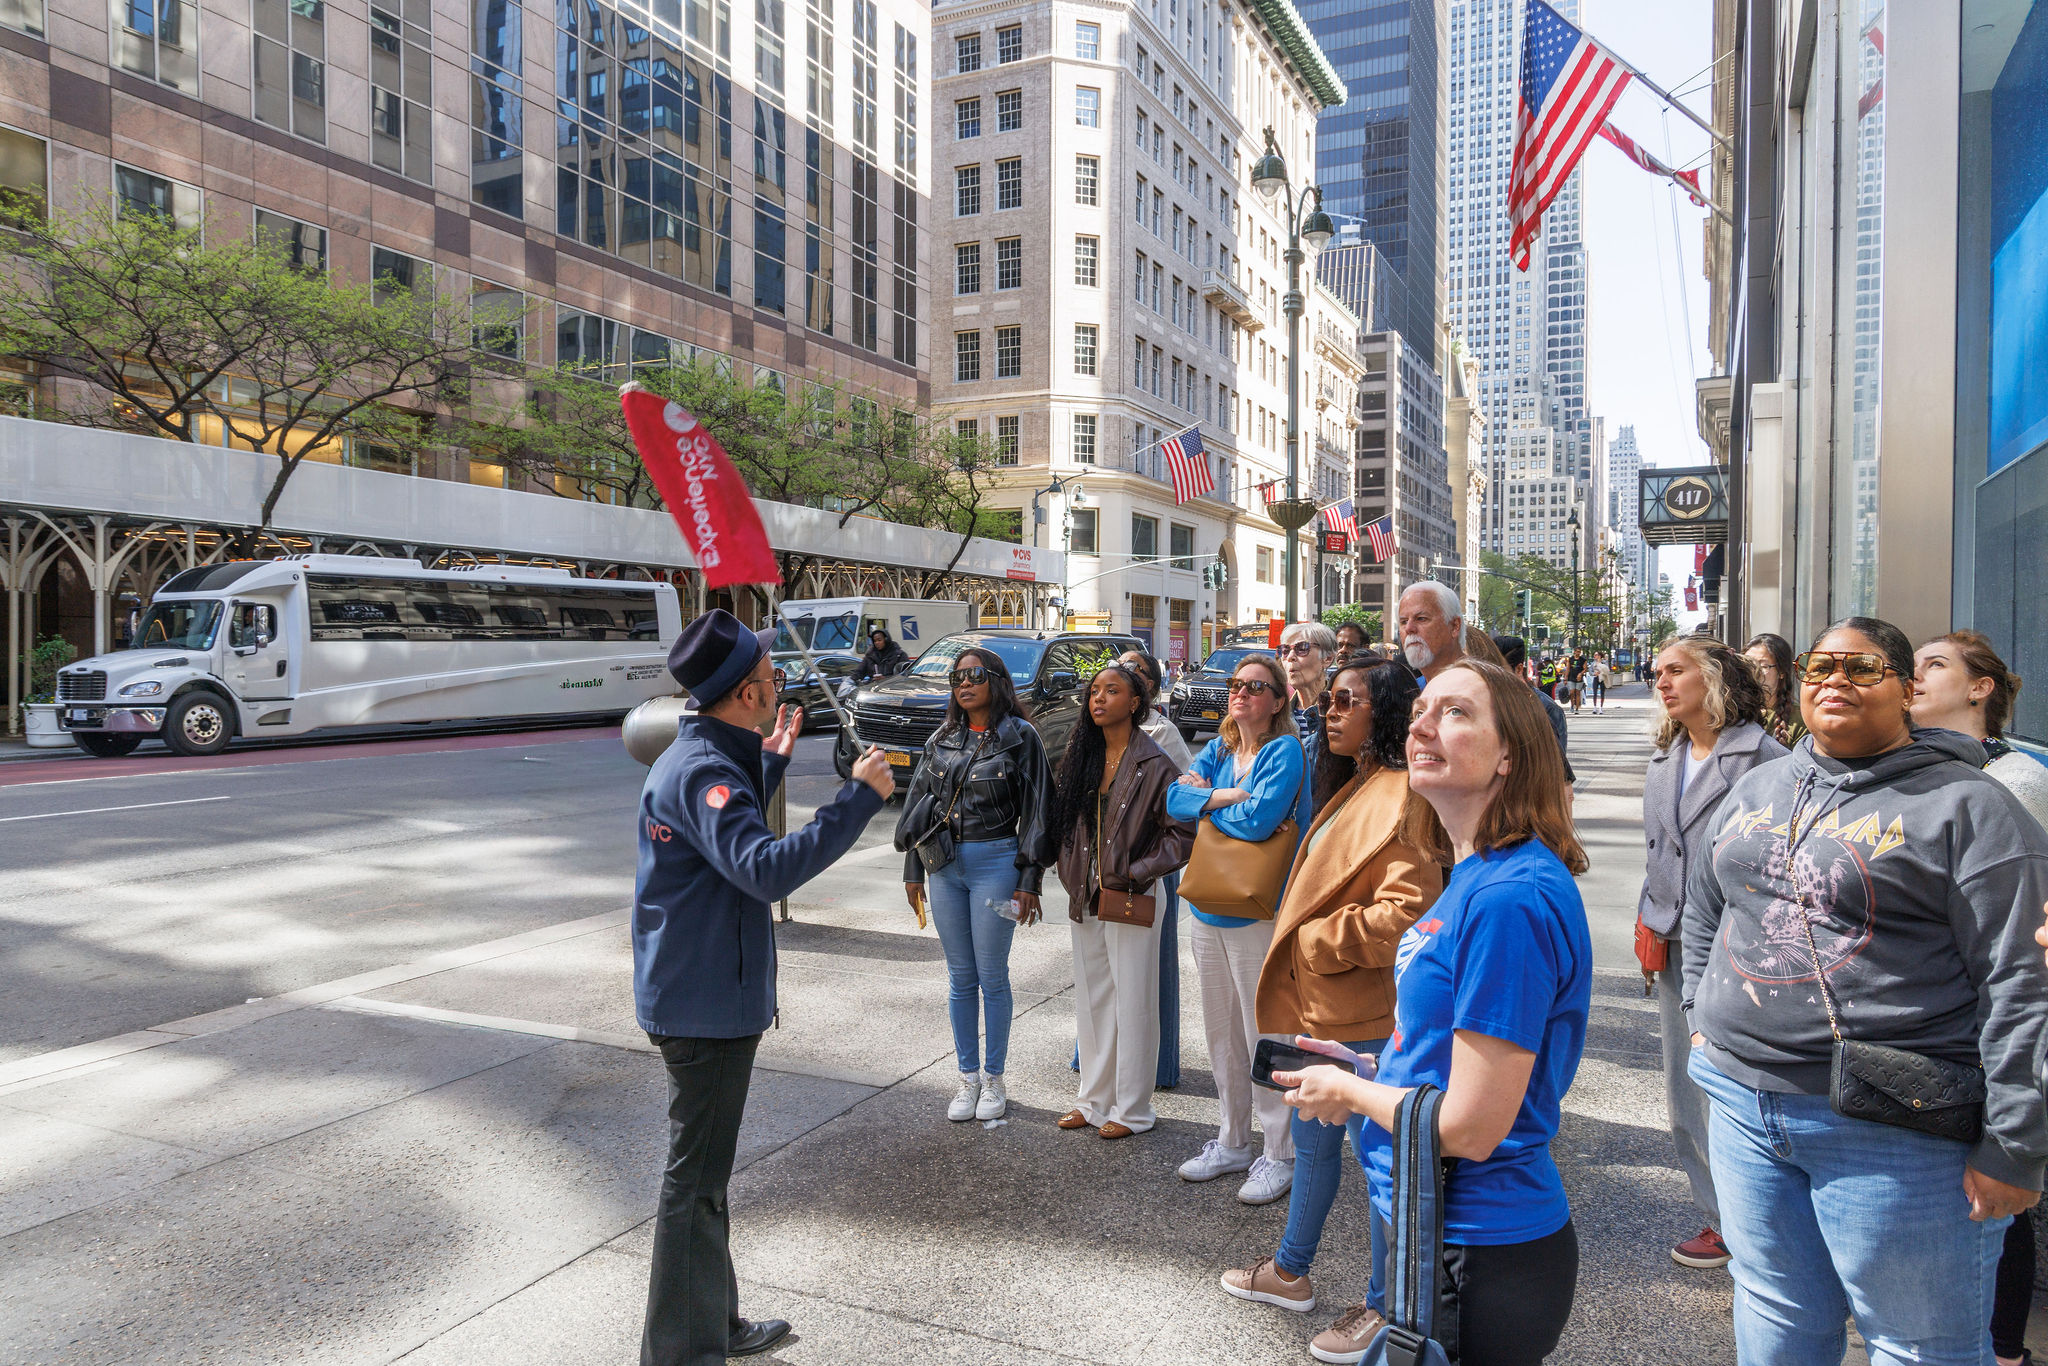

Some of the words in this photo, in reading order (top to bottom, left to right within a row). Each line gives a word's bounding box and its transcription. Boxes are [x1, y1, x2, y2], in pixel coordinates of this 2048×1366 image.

[693, 435, 719, 480] NYC
[676, 436, 721, 568] Experience
[1674, 489, 1702, 505] 417
[1019, 550, 1031, 560] CVS
[646, 816, 673, 843] YC
